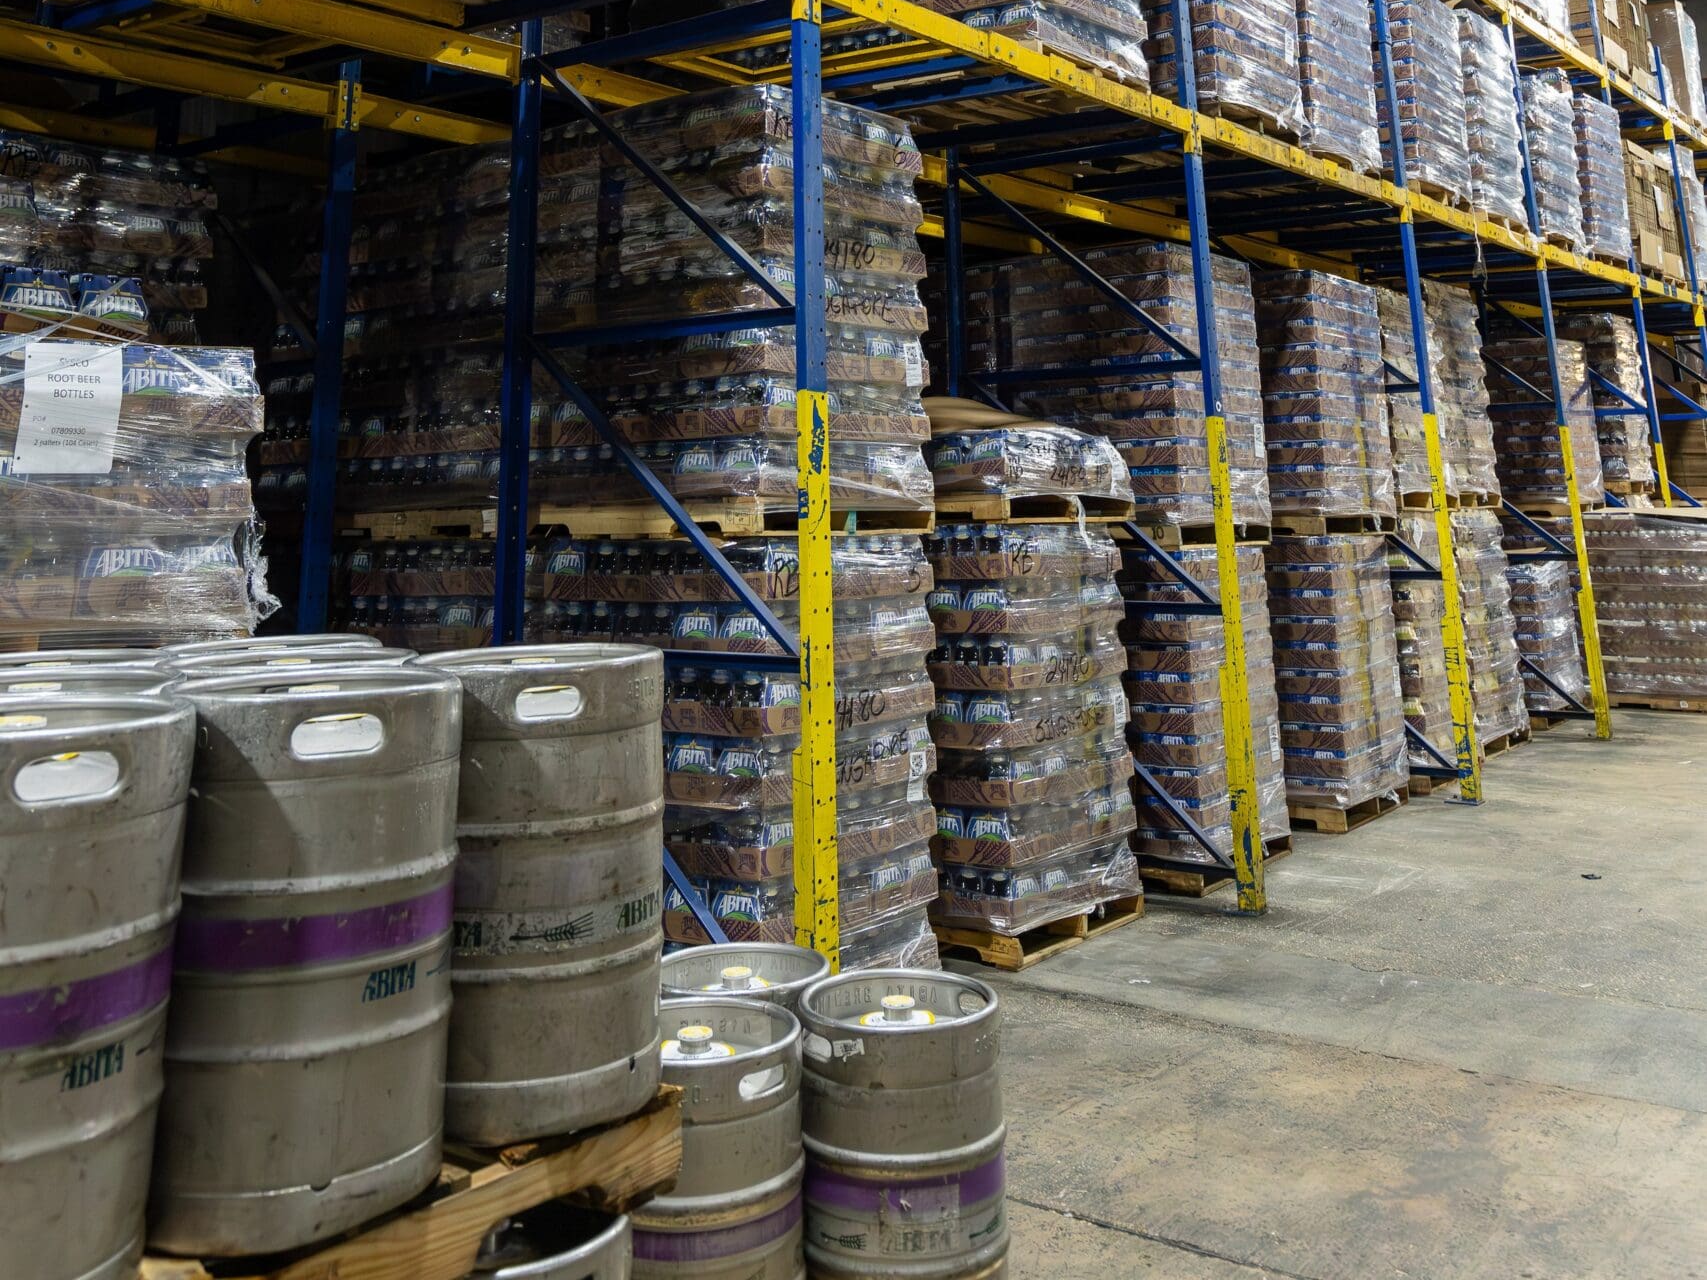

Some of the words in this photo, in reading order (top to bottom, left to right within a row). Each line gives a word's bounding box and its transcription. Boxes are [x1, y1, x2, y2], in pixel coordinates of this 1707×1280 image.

[865, 125, 891, 141] ABITA
[894, 134, 918, 148] ABITA
[825, 240, 875, 269] 4180
[11, 288, 66, 308] ABITA
[87, 296, 144, 318] ABITA
[869, 341, 894, 355] ABITA
[48, 374, 75, 384] ROOT
[77, 375, 101, 384] BEER
[123, 368, 182, 394] ABITA
[54, 389, 95, 399] BOTTLES
[680, 455, 711, 467] ABITA
[722, 450, 756, 467] ABITA
[96, 548, 156, 577] ABITA
[177, 544, 234, 571] ABITA
[969, 593, 1001, 608] ABITA
[876, 611, 898, 625] ABITA
[907, 607, 929, 621] ABITA
[679, 617, 711, 634] ABITA
[727, 617, 762, 634] ABITA
[1013, 648, 1031, 661] ABITA
[1040, 646, 1061, 658] ABITA
[972, 704, 1004, 720] ABITA
[910, 728, 930, 743] ABITA
[675, 750, 710, 768] ABITA
[722, 752, 758, 770] ABITA
[1045, 756, 1066, 769] ABITA
[1015, 762, 1035, 774] ABITA
[1091, 801, 1112, 816] ABITA
[973, 821, 1005, 837] ABITA
[909, 856, 931, 871] ABITA
[876, 868, 902, 885] ABITA
[1045, 870, 1068, 885] ABITA
[1017, 879, 1038, 892] ABITA
[618, 889, 659, 928] ABITA
[718, 895, 754, 915] ABITA
[362, 961, 416, 1003] ABITA
[62, 1044, 124, 1091] ABITA
